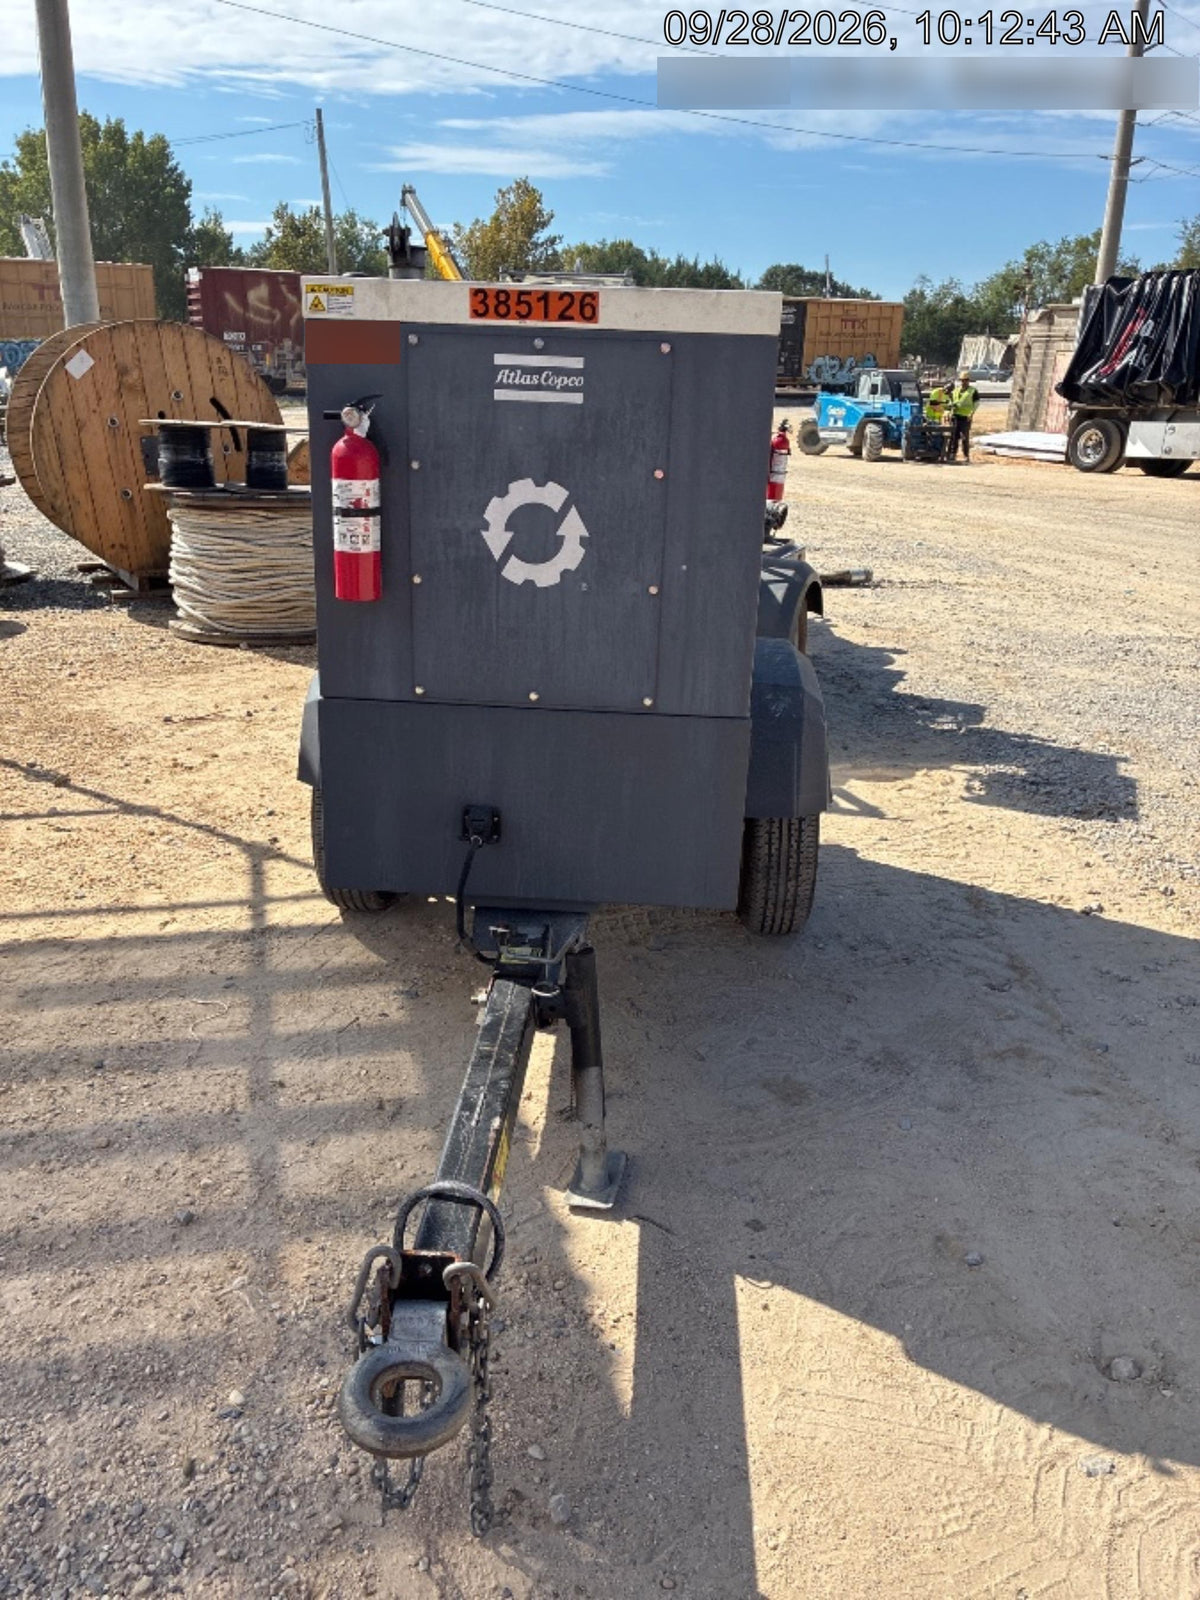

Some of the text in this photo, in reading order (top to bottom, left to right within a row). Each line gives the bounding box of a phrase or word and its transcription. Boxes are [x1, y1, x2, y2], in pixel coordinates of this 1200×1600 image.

[472, 288, 597, 322] 385126
[496, 369, 584, 390] Atlas Copco
